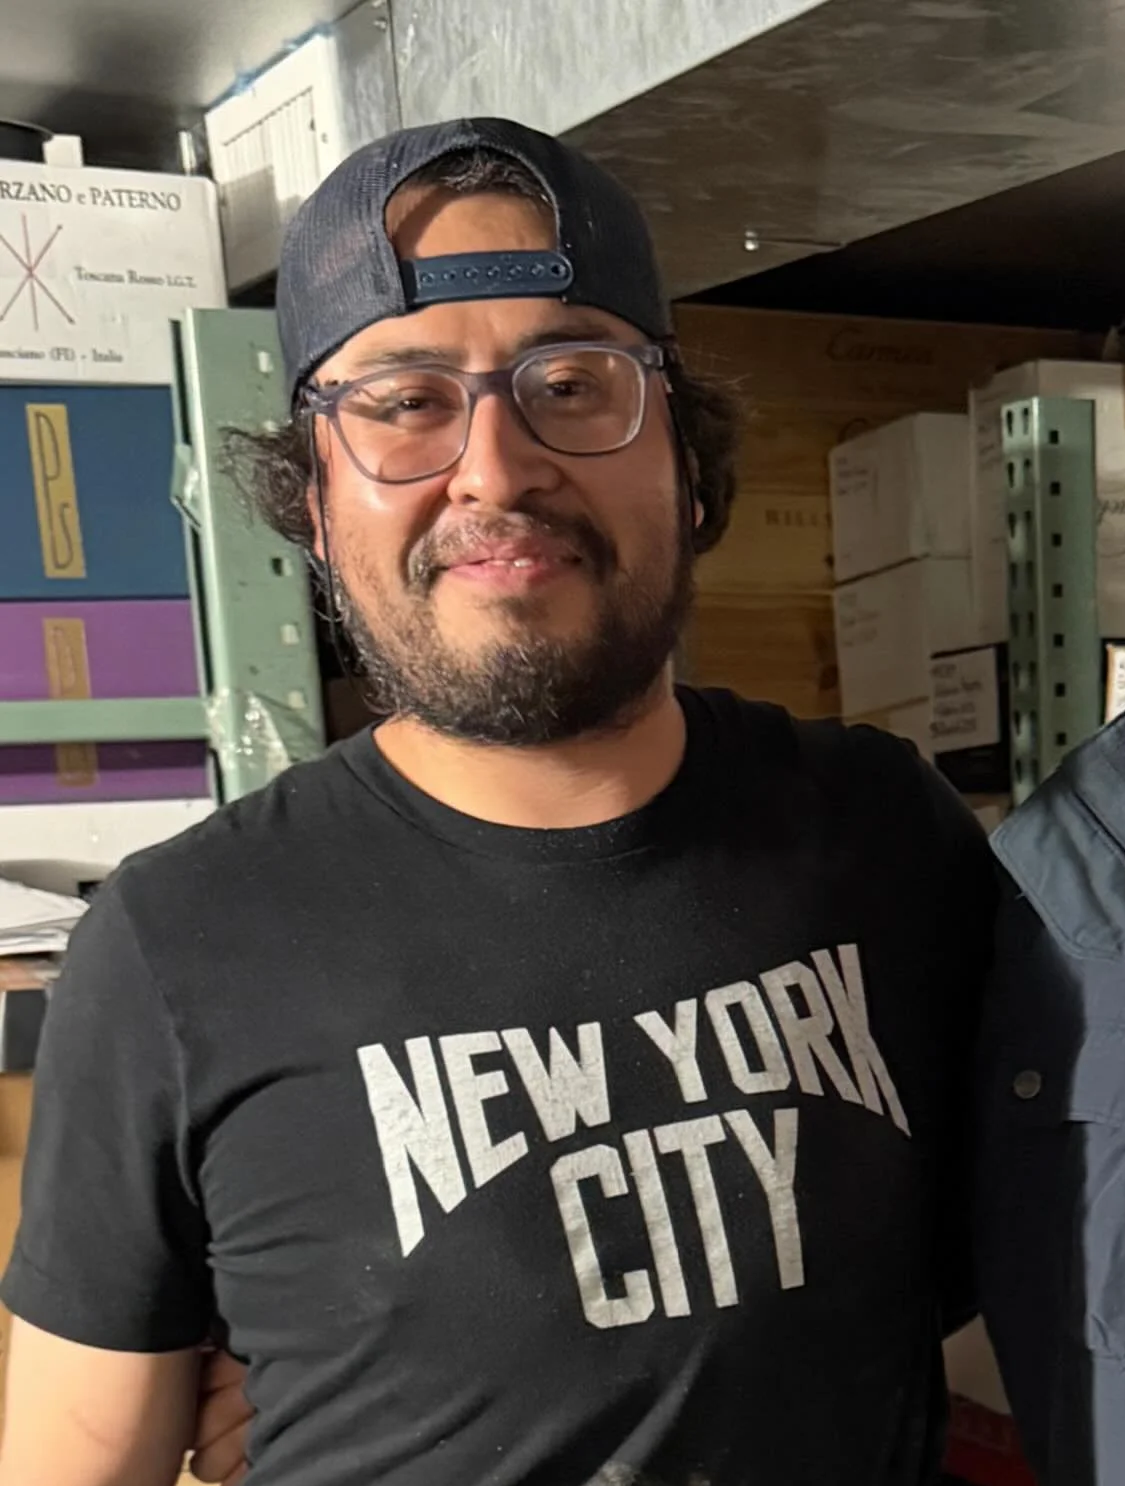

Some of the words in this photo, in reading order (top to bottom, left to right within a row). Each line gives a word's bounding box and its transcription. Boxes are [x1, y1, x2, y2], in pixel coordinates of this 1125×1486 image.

[77, 191, 86, 205] e
[89, 186, 182, 211] PATERNO
[357, 1022, 611, 1258] NEW
[633, 944, 911, 1138] YORK
[550, 1107, 805, 1329] CITY
